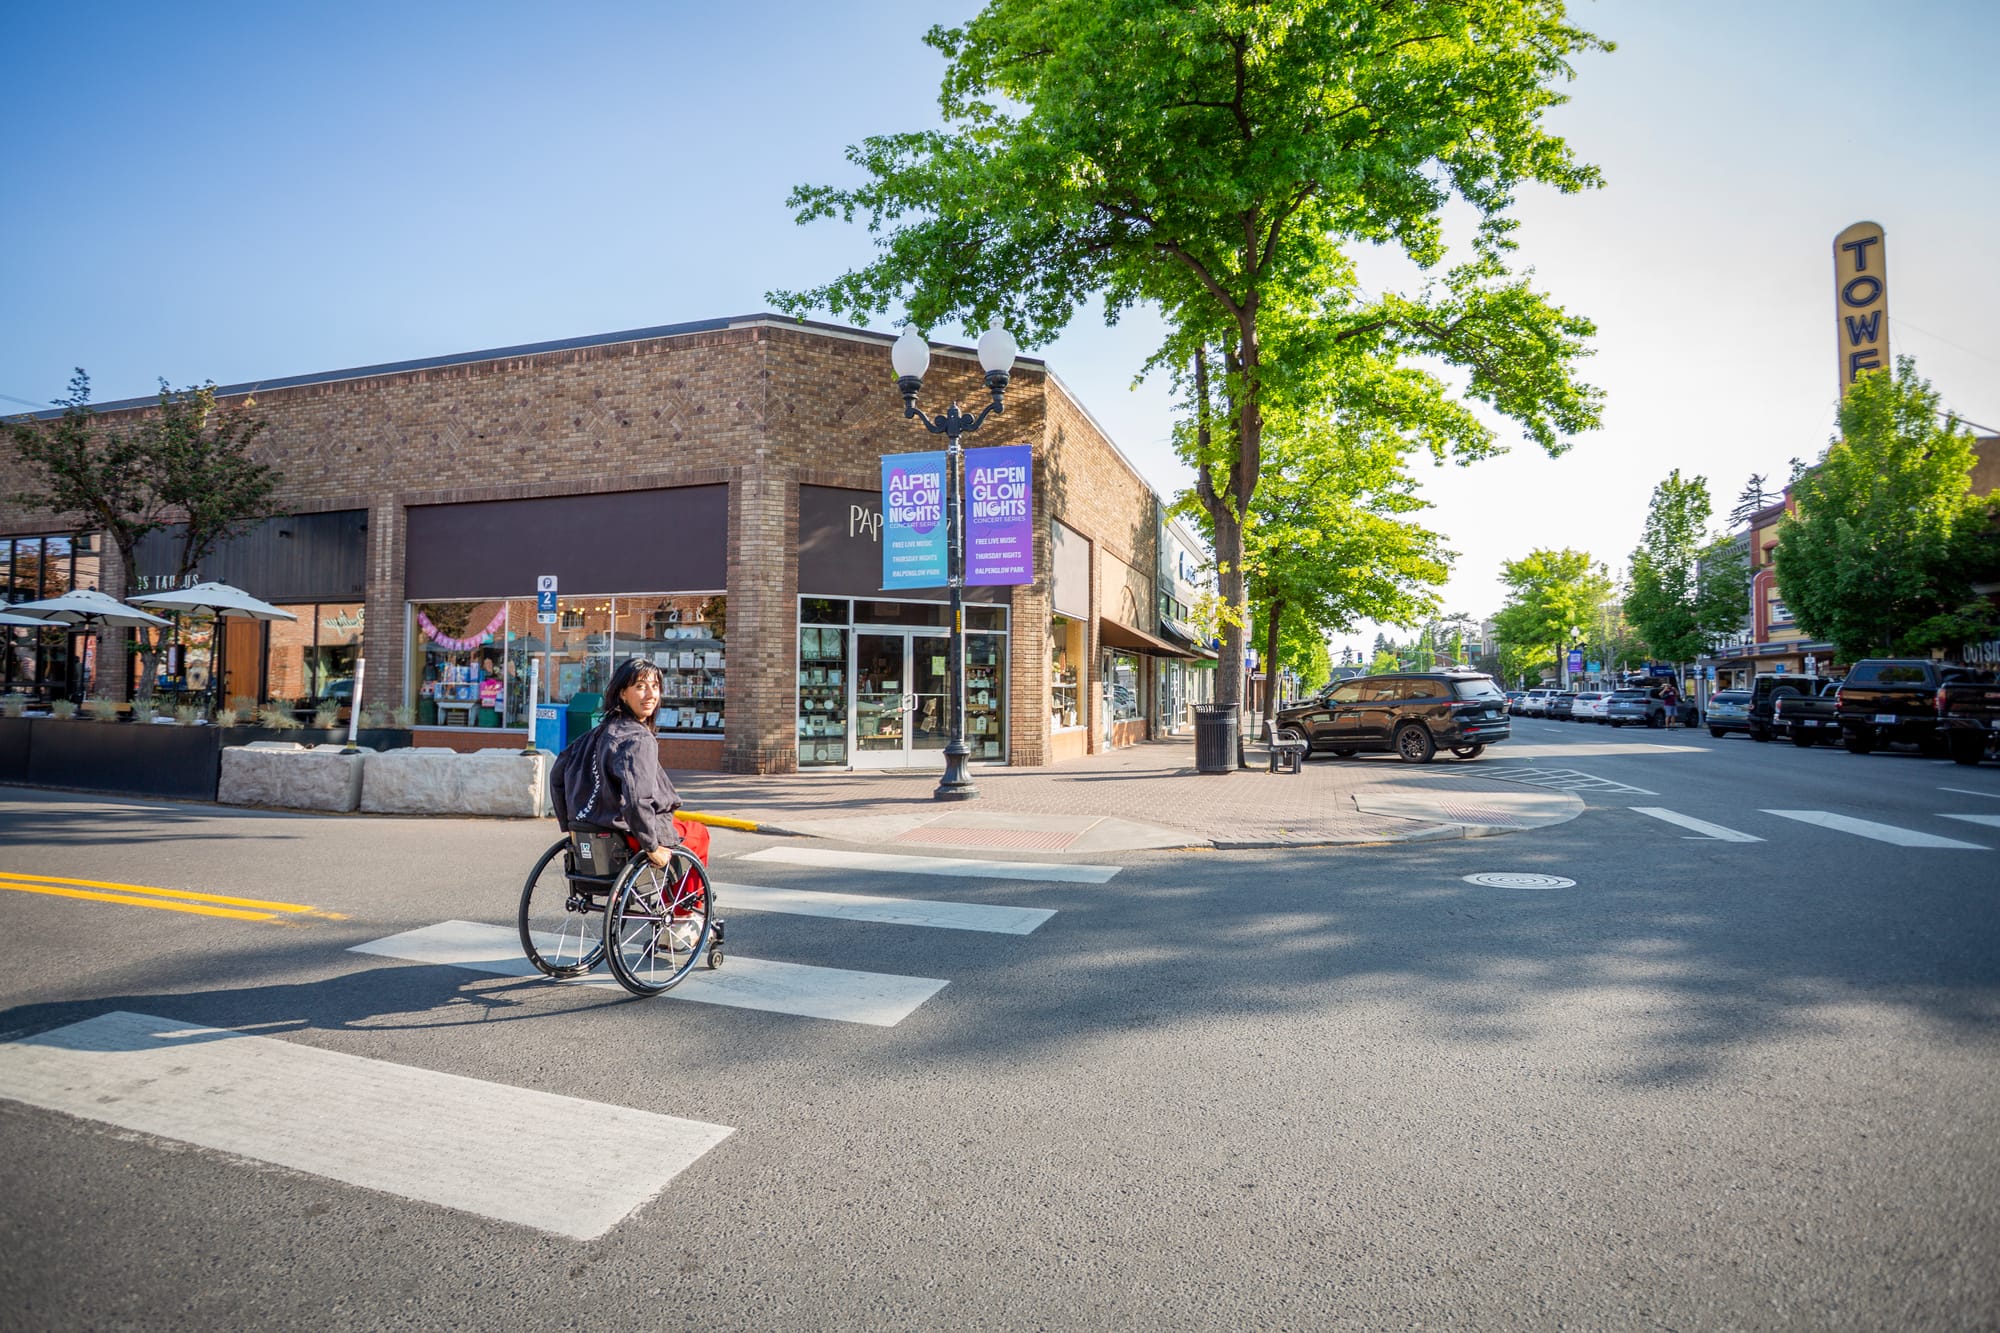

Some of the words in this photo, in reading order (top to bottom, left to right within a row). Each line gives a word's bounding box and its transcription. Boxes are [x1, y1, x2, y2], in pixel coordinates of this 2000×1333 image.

[1841, 235, 1883, 384] TOWE
[889, 472, 939, 491] ALPEN
[973, 466, 1025, 485] ALPEN
[889, 488, 940, 507] GLOW
[972, 483, 1025, 501] GLOW
[889, 504, 941, 523] NIGHTS
[973, 499, 1026, 518] NIGHTS
[889, 521, 918, 529] CONCERT
[973, 516, 1003, 524] CONCERT
[892, 540, 904, 548] FREE
[904, 540, 916, 548] LIVE
[916, 539, 933, 547] MUSIC
[1000, 536, 1017, 544] MUSIC
[892, 555, 918, 563] THURSDAY
[918, 554, 938, 562] NIGHTS
[975, 552, 1002, 560] THURSDAY
[1002, 551, 1022, 559] NIGHTS
[926, 568, 940, 576] PARK
[974, 567, 1009, 575] @ALPENGLOW
[1010, 566, 1025, 574] PARK
[155, 574, 200, 590] TAUUS
[543, 591, 551, 604] 2
